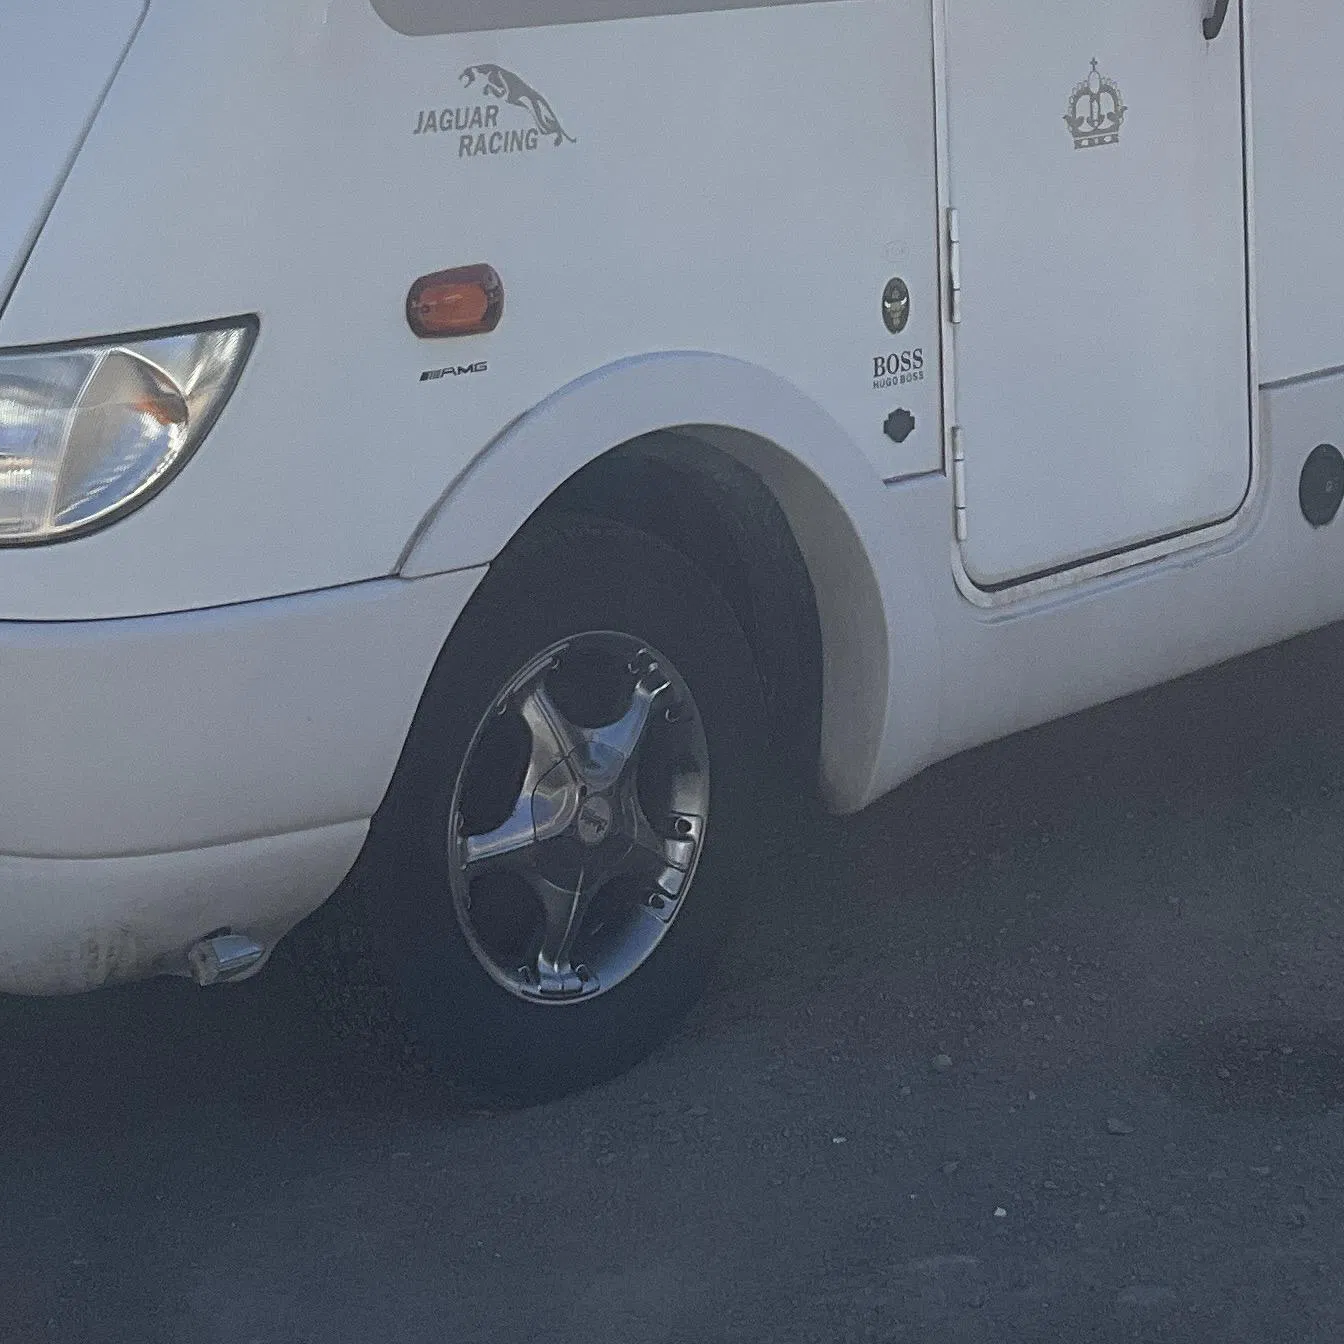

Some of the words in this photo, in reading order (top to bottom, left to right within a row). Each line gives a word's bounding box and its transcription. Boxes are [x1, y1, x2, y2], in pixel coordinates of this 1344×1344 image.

[413, 105, 499, 134] JAGUAR
[459, 127, 539, 157] RACING
[439, 360, 488, 379] AMG
[873, 348, 923, 378] BOSS
[873, 376, 898, 389] HUGO
[900, 371, 924, 385] BOSS
